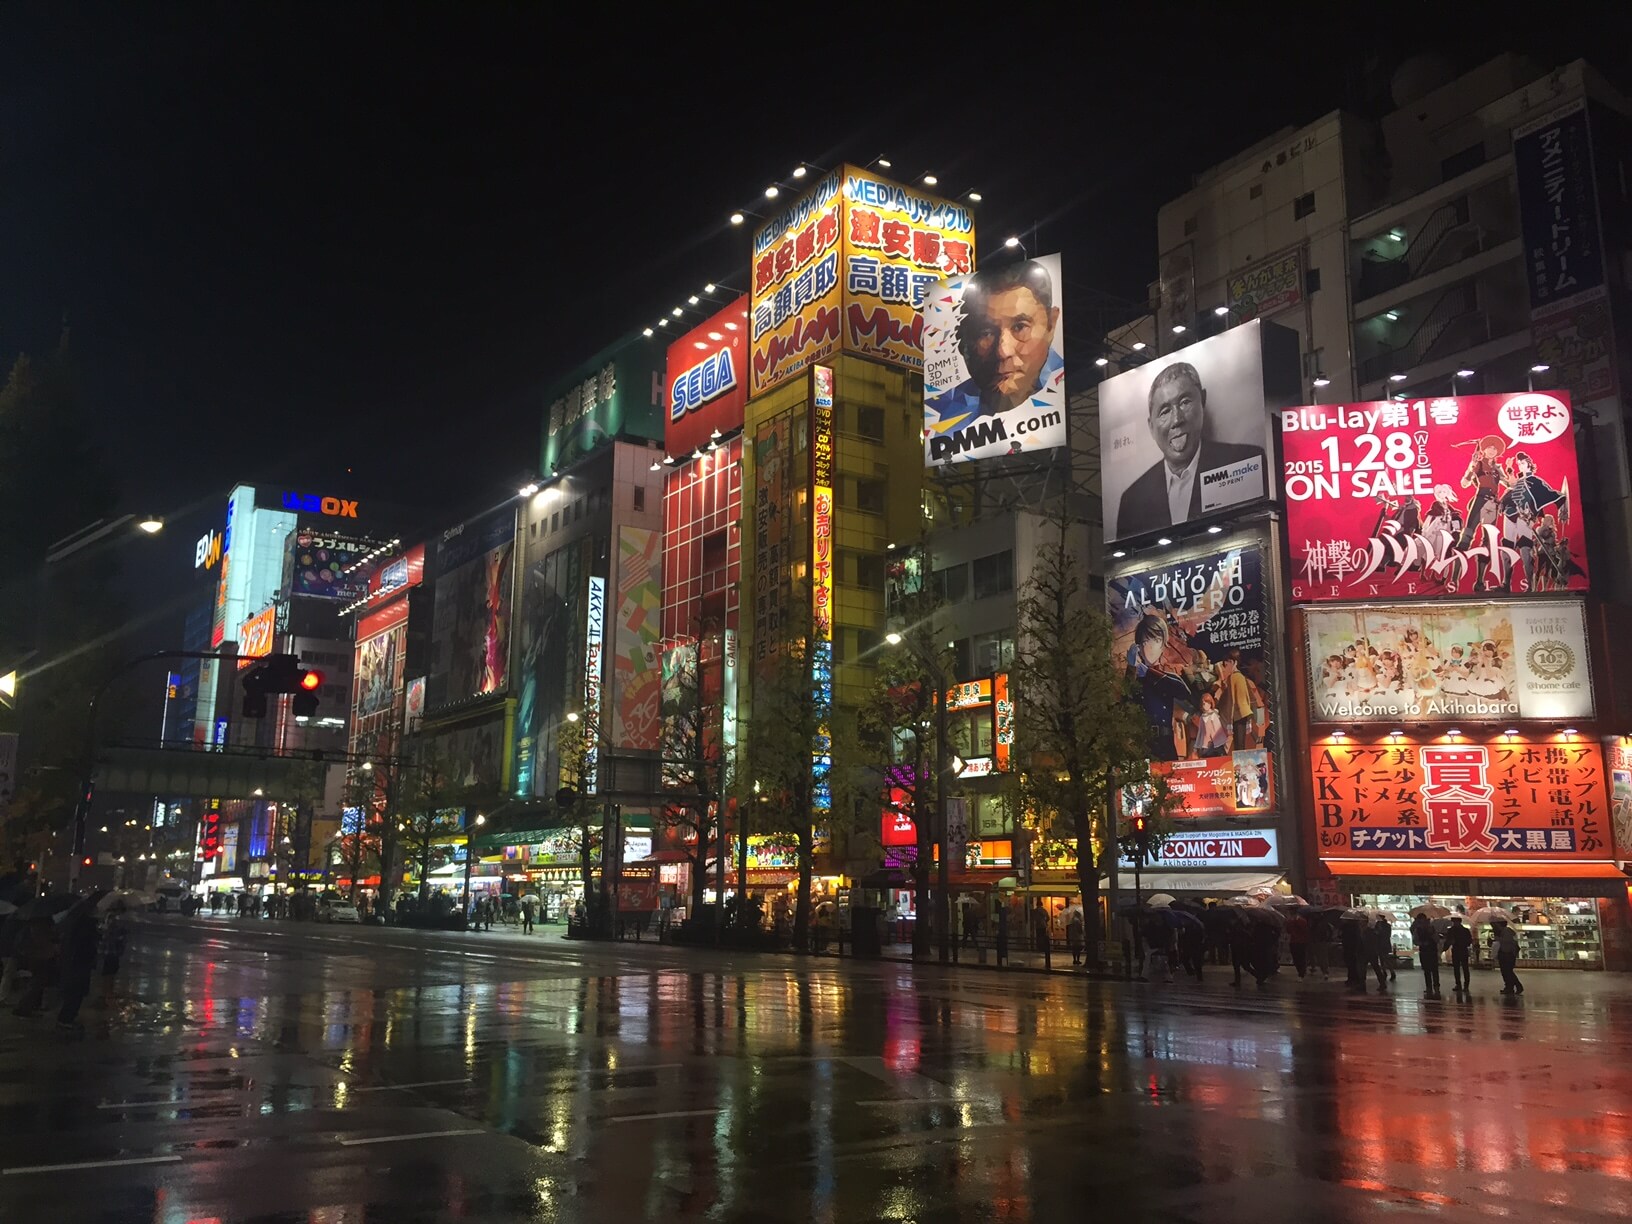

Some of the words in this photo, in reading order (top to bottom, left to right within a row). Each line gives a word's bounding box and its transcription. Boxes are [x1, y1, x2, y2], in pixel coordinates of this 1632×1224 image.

[755, 204, 839, 296] 激安販売
[849, 207, 972, 276] 激安販売
[754, 251, 838, 342] 高額買取
[753, 305, 841, 389] Mulan
[785, 359, 805, 376] AKIBA
[927, 357, 952, 373] DMM
[671, 348, 736, 420] SEGA
[928, 370, 943, 382] 3D
[930, 375, 953, 389] PRINT
[816, 408, 831, 418] DVD
[817, 434, 829, 443] CD
[929, 410, 1061, 461] DMM.com
[1284, 461, 1325, 476] 2015
[1320, 431, 1416, 474] 1.28
[1285, 476, 1342, 501] ON
[1351, 468, 1435, 499] SALE
[590, 579, 603, 622] AKKY
[1195, 609, 1260, 635] コミック第2巻
[726, 634, 736, 668] GAME
[1319, 700, 1399, 717] Welcome
[1404, 701, 1421, 716] to
[1427, 698, 1519, 716] Akihabara
[1210, 777, 1232, 786] コミック
[1345, 748, 1371, 823] アイドル
[1369, 749, 1393, 803] アニメ
[1391, 748, 1421, 826] 美少女系
[1495, 748, 1522, 826] フィギュア
[1519, 748, 1543, 805] ホビー
[1544, 747, 1575, 827] 携帯電話
[1420, 746, 1500, 852] 買取
[1570, 747, 1603, 853] アップルとか
[1163, 840, 1217, 858] COMIC
[1218, 840, 1244, 857] ZIN
[1351, 829, 1424, 849] チケット
[1500, 829, 1573, 850] 大黒屋
[1163, 859, 1208, 867] Akihabara
